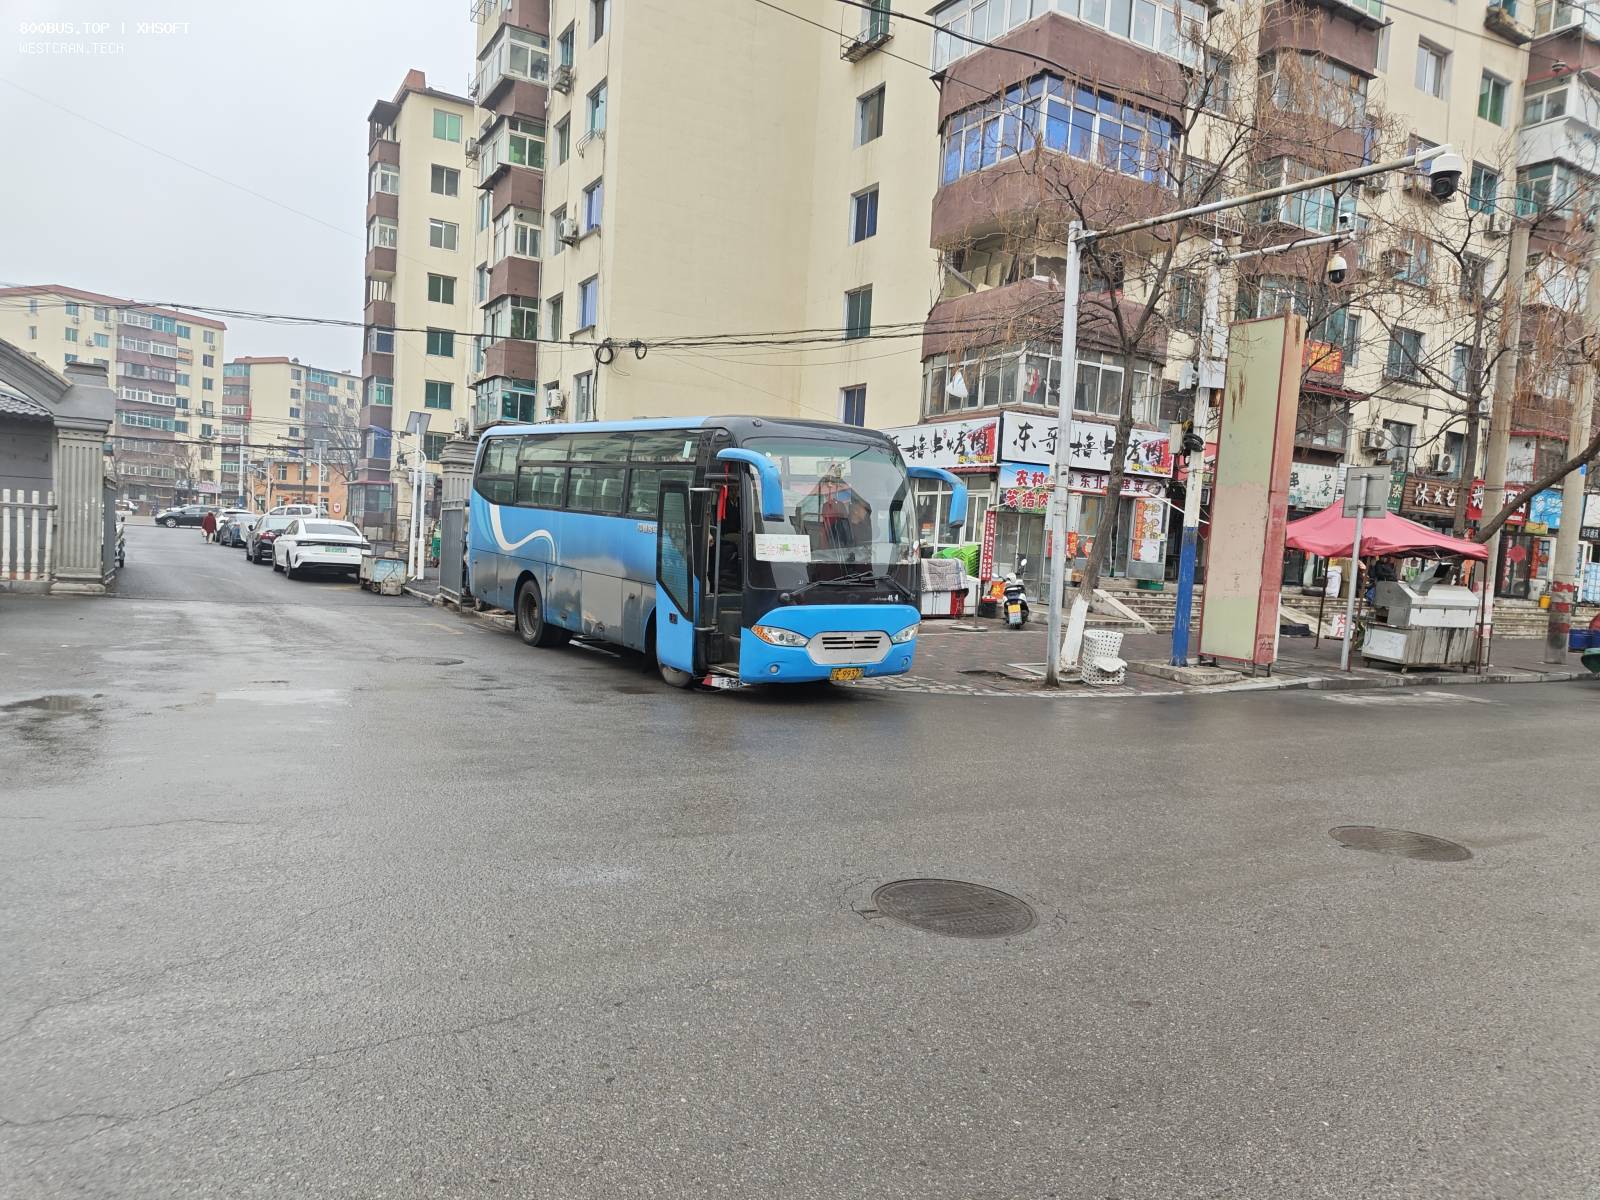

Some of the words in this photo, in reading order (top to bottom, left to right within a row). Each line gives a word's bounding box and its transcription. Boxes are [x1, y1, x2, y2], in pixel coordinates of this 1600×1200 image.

[1016, 470, 1045, 487] 农村
[1006, 488, 1049, 508] 笨猪肉
